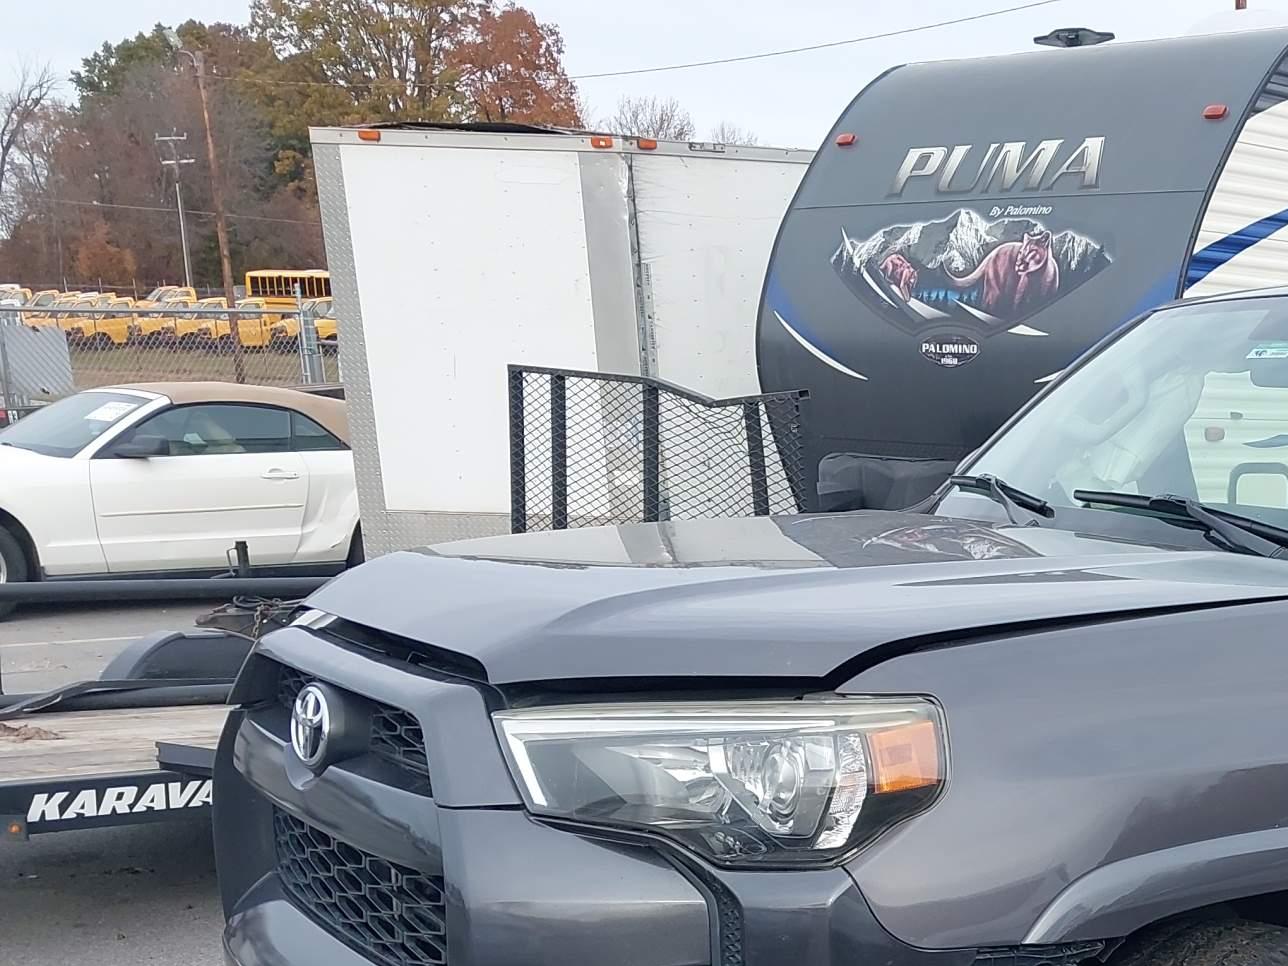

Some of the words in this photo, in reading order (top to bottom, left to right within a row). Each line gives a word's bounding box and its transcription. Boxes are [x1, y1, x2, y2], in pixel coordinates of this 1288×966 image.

[886, 136, 1105, 197] PUMA
[989, 206, 1004, 217] By
[1003, 205, 1053, 216] Palomino
[921, 343, 978, 354] PALOMINO
